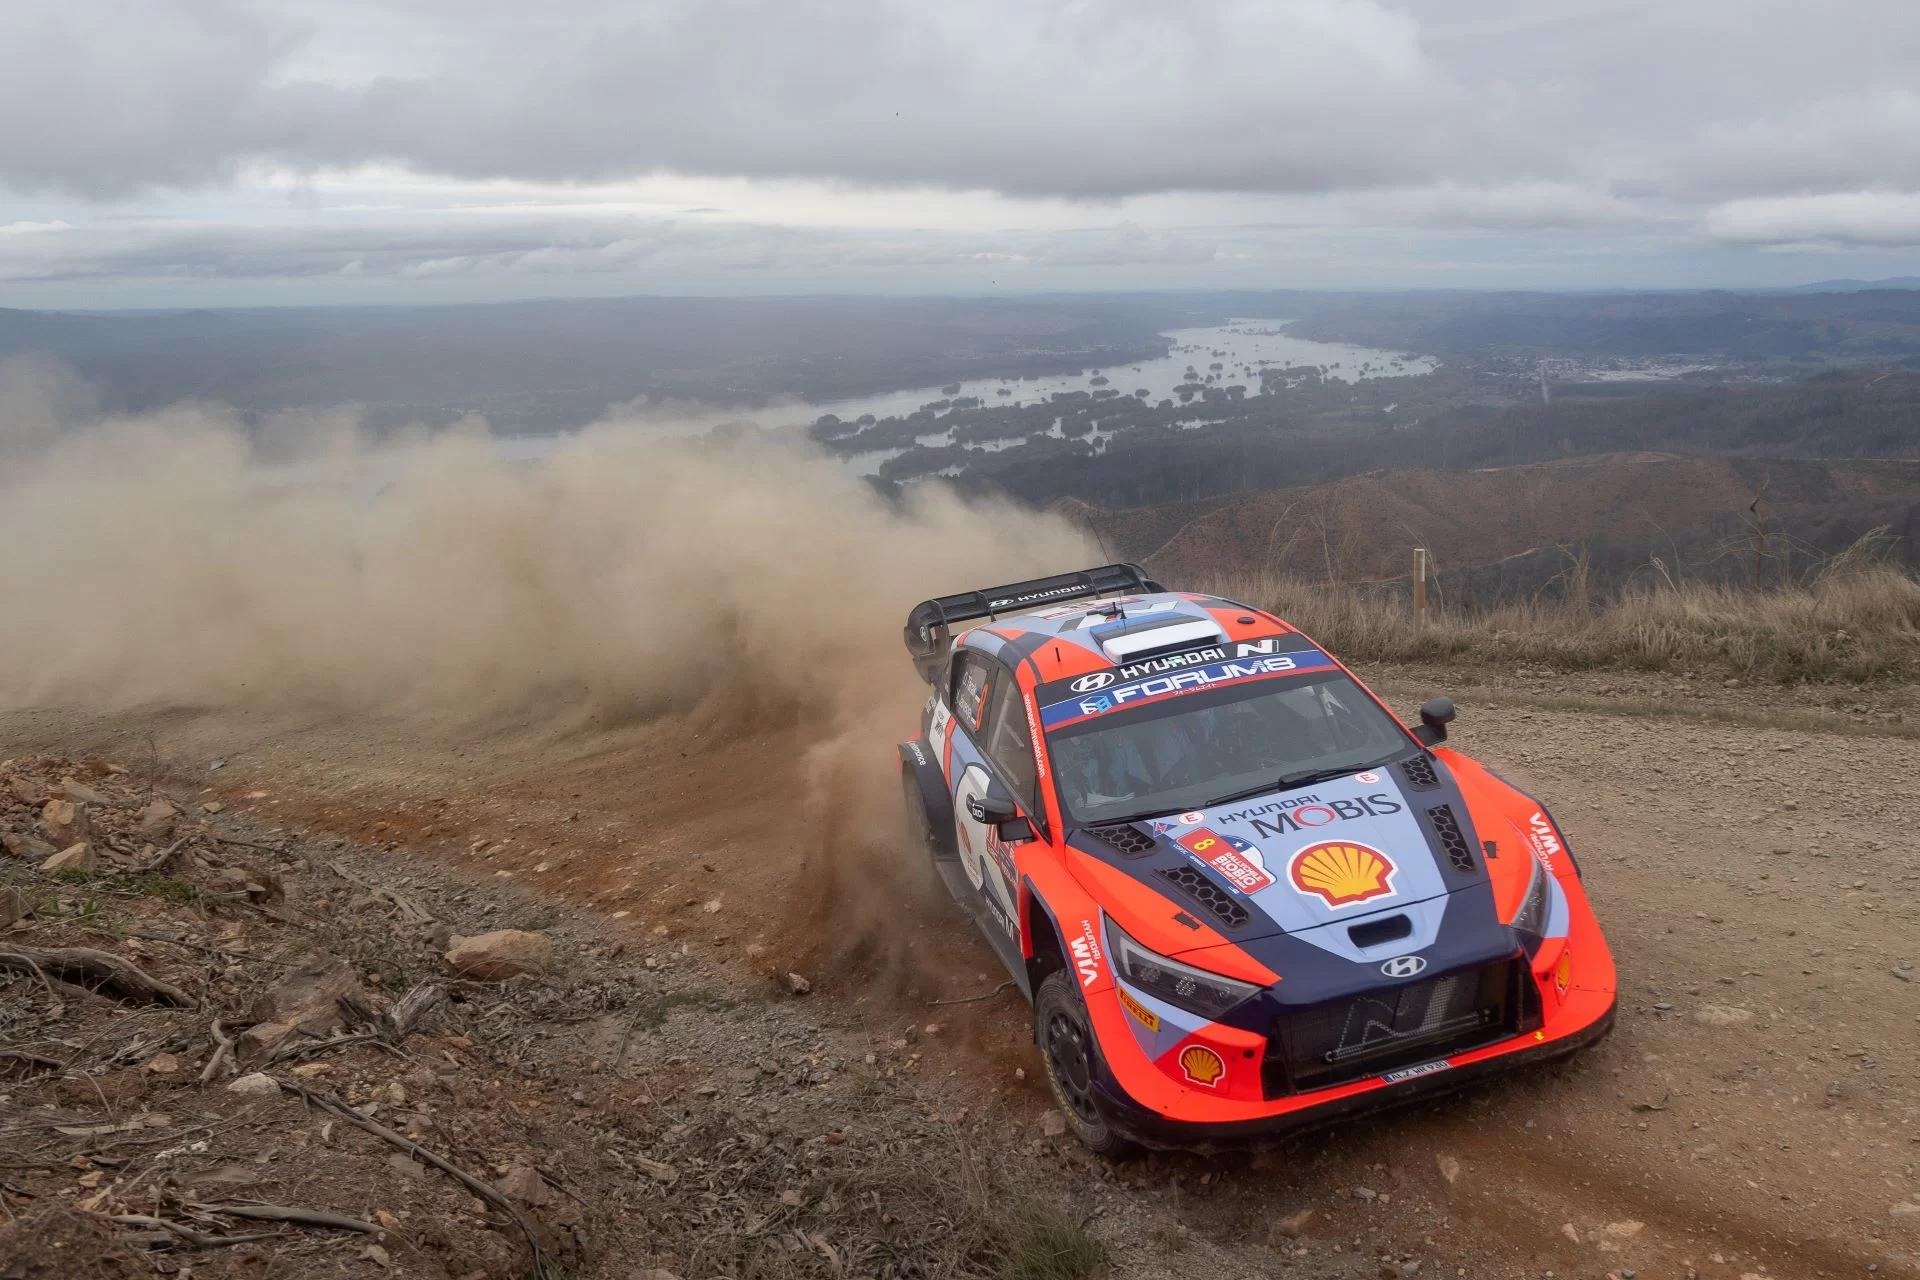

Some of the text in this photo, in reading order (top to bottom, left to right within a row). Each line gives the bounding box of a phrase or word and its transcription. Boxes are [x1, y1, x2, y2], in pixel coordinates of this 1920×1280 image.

[1017, 584, 1087, 602] HYUNDAI
[1120, 638, 1279, 679] HYUNDAI N
[1111, 657, 1297, 704] FORUM8
[1217, 794, 1322, 825] HYUNDAI
[1248, 793, 1402, 840] MOBIS
[1192, 838, 1217, 852] 8
[1529, 833, 1555, 871] HYUNDAI
[1081, 919, 1102, 960] HYUNDAI
